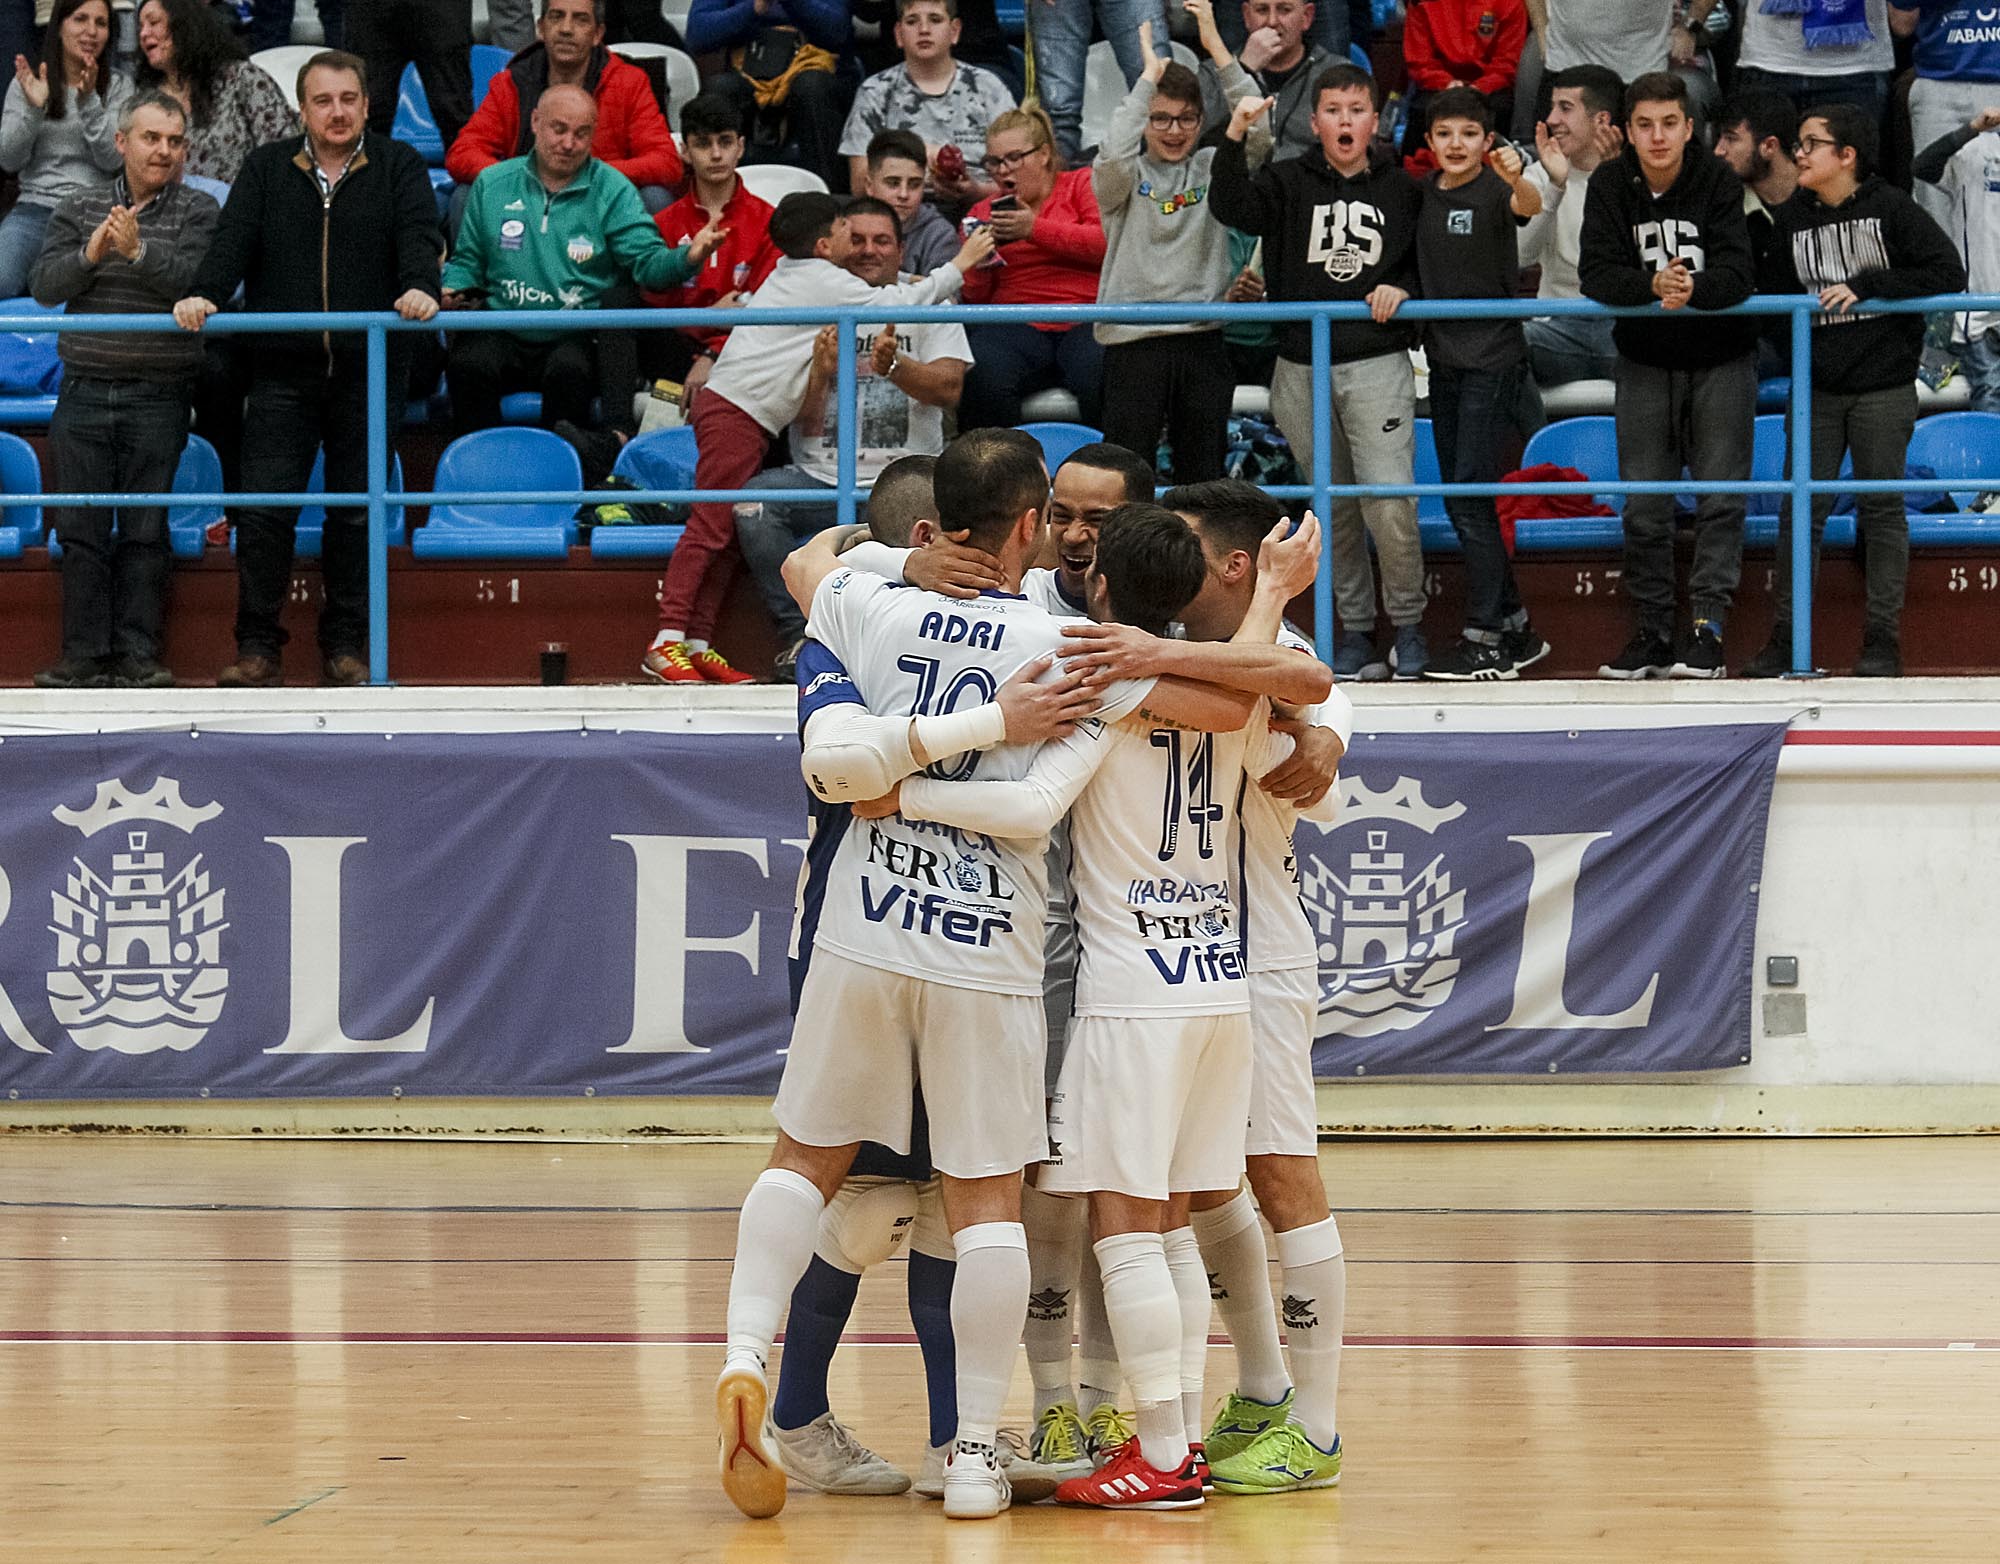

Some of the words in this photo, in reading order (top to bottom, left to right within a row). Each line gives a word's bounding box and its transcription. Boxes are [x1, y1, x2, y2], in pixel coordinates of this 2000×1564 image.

[476, 578, 520, 603] 51
[1948, 566, 1999, 592] 59
[919, 611, 1006, 652] ADRI
[1149, 728, 1224, 862] 14
[860, 874, 1014, 948] Vifer
